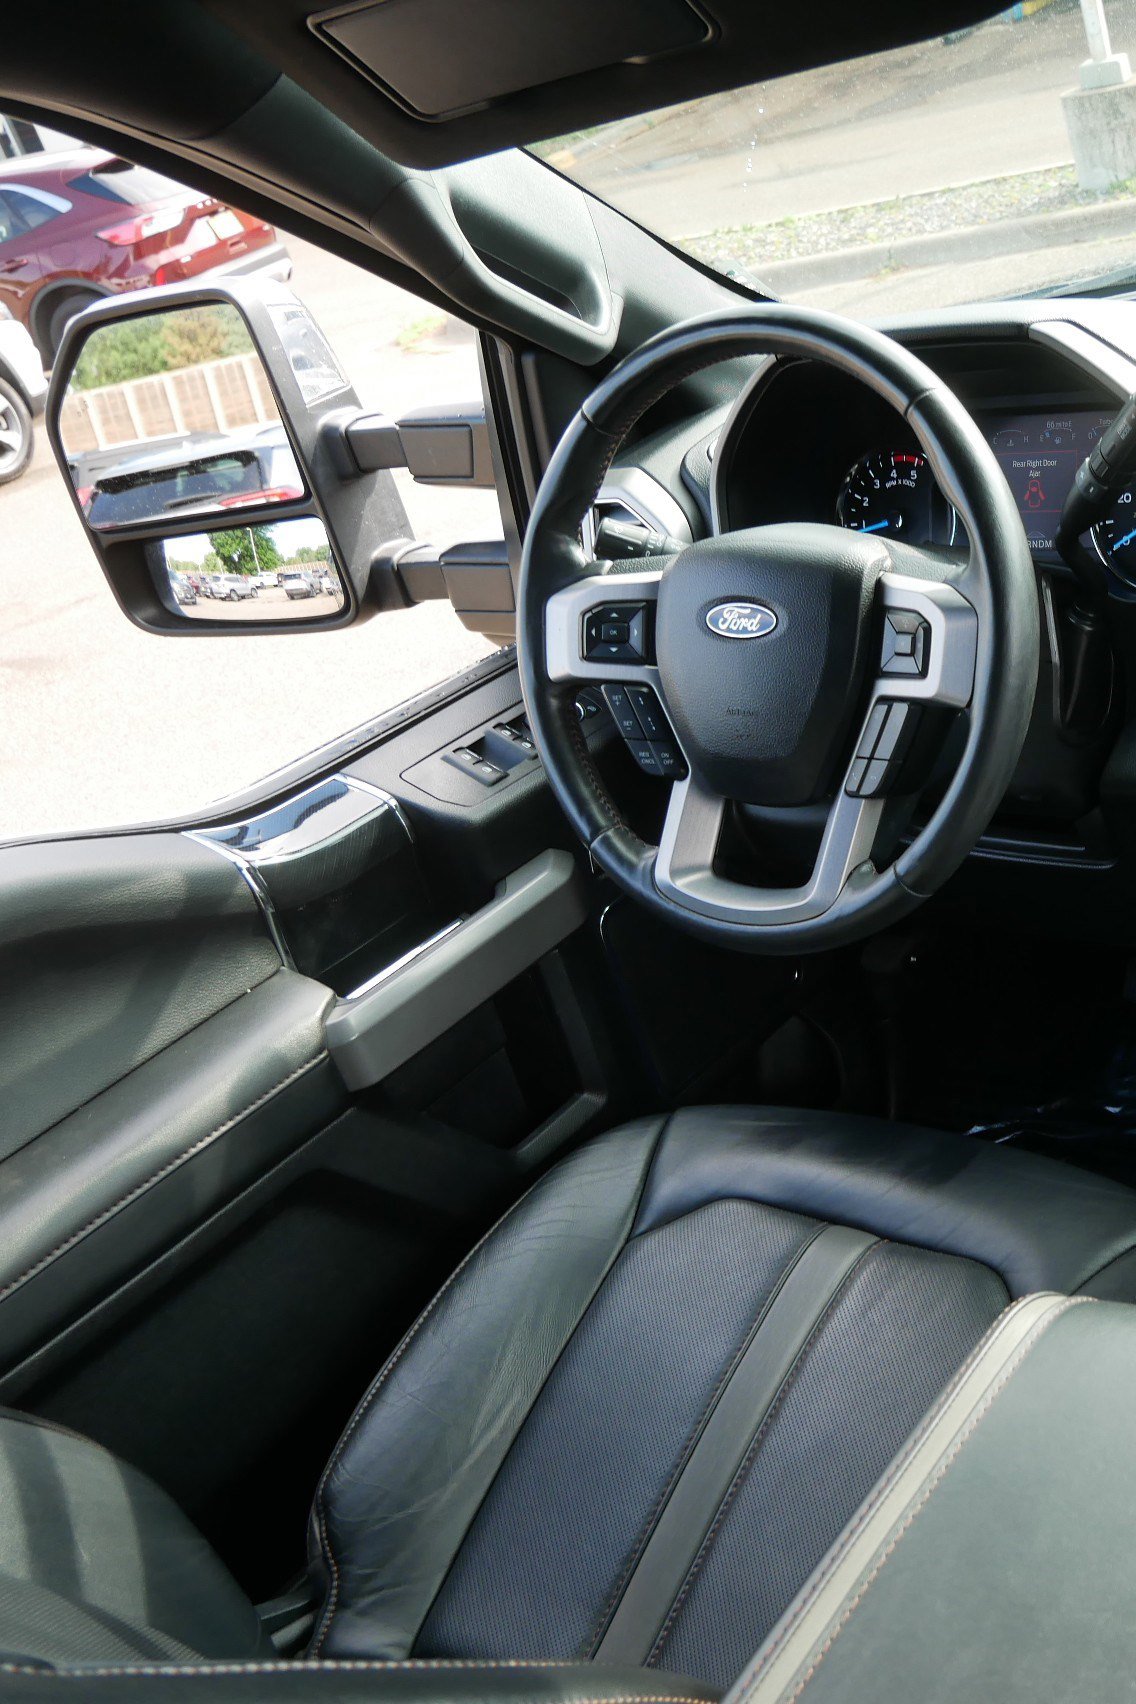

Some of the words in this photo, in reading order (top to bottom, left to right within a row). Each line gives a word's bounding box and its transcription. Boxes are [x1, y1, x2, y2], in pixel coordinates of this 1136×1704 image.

[1012, 460, 1026, 468] Rear
[1026, 459, 1042, 469] Right
[1042, 459, 1057, 467] Door
[890, 469, 897, 478] 4
[910, 470, 917, 480] 5
[1028, 469, 1041, 479] Ajar
[873, 479, 880, 489] 3
[885, 479, 897, 489] RPM
[902, 479, 916, 488] 1000
[863, 496, 869, 507] 2
[1117, 492, 1132, 504] 20
[718, 606, 761, 632] Ford
